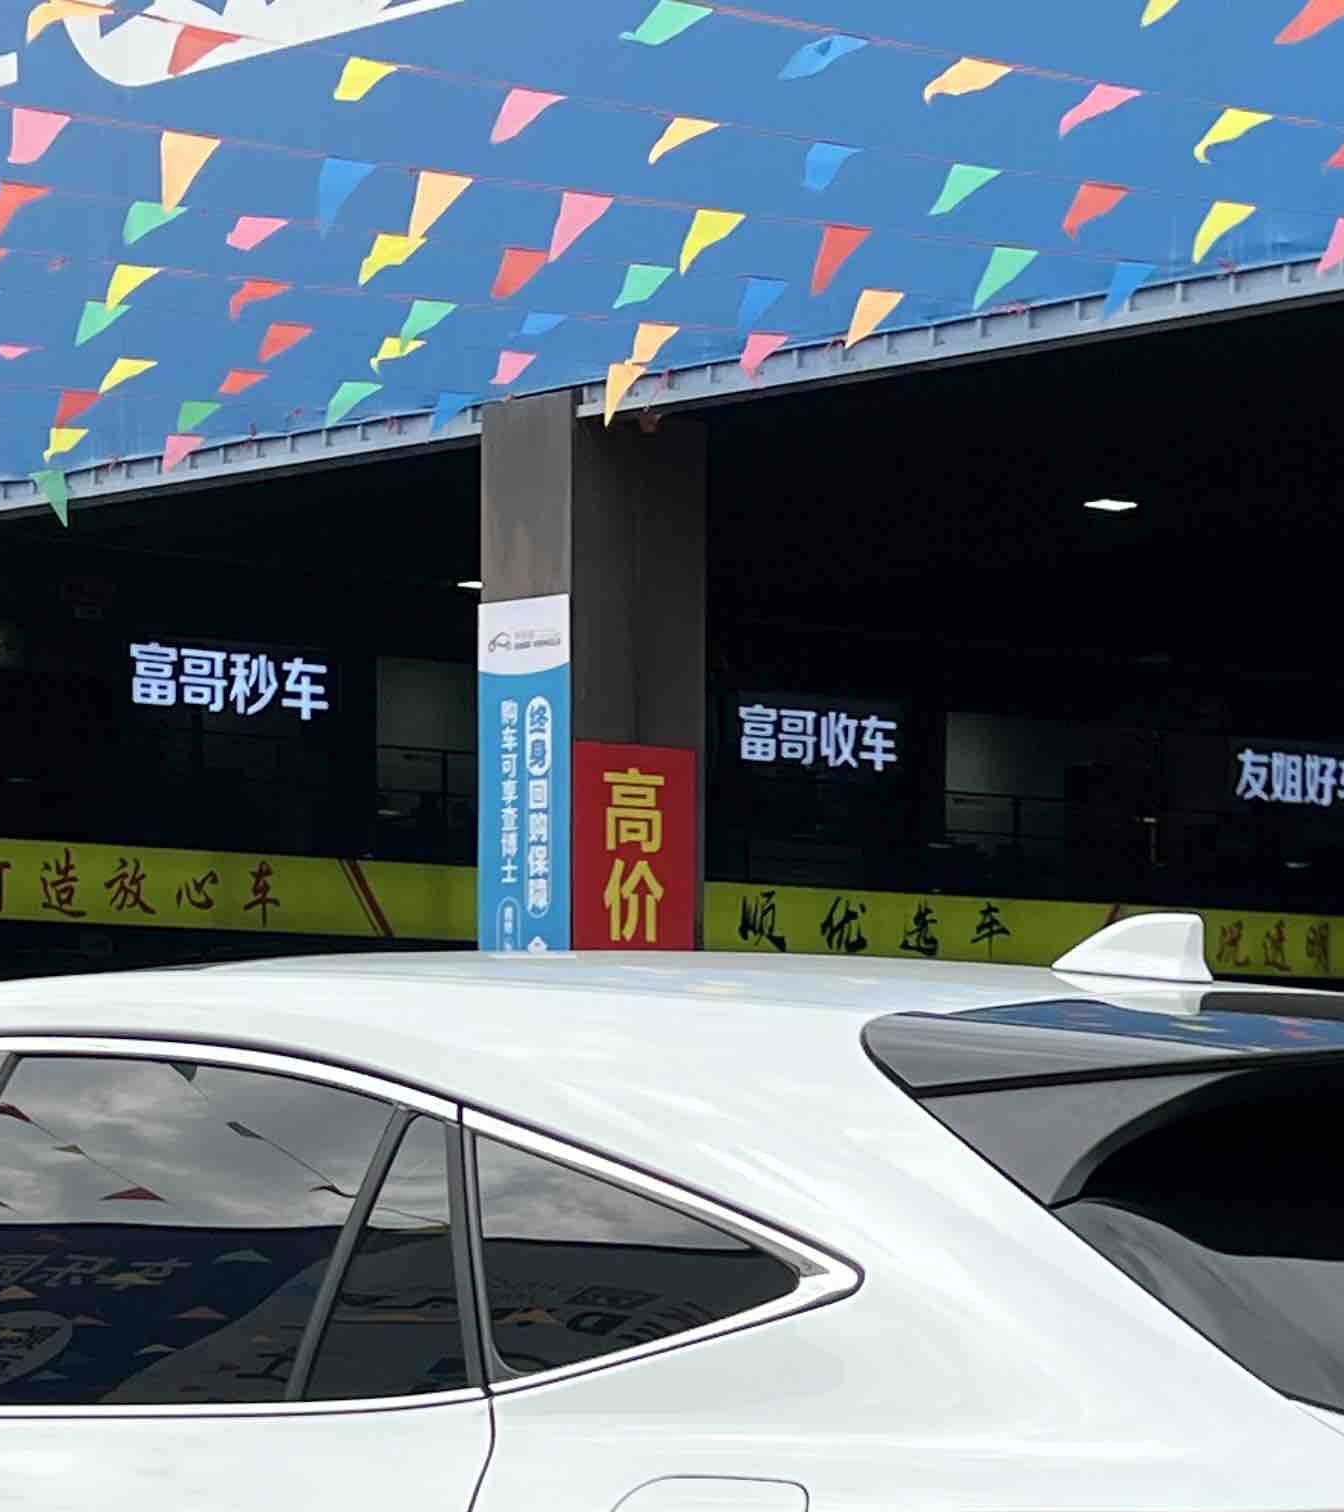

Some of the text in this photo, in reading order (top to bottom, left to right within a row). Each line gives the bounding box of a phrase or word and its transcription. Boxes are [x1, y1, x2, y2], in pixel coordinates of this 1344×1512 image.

[128, 641, 330, 721] 富哥秒车
[737, 703, 898, 772] 富哥收车
[602, 767, 665, 944] 高价
